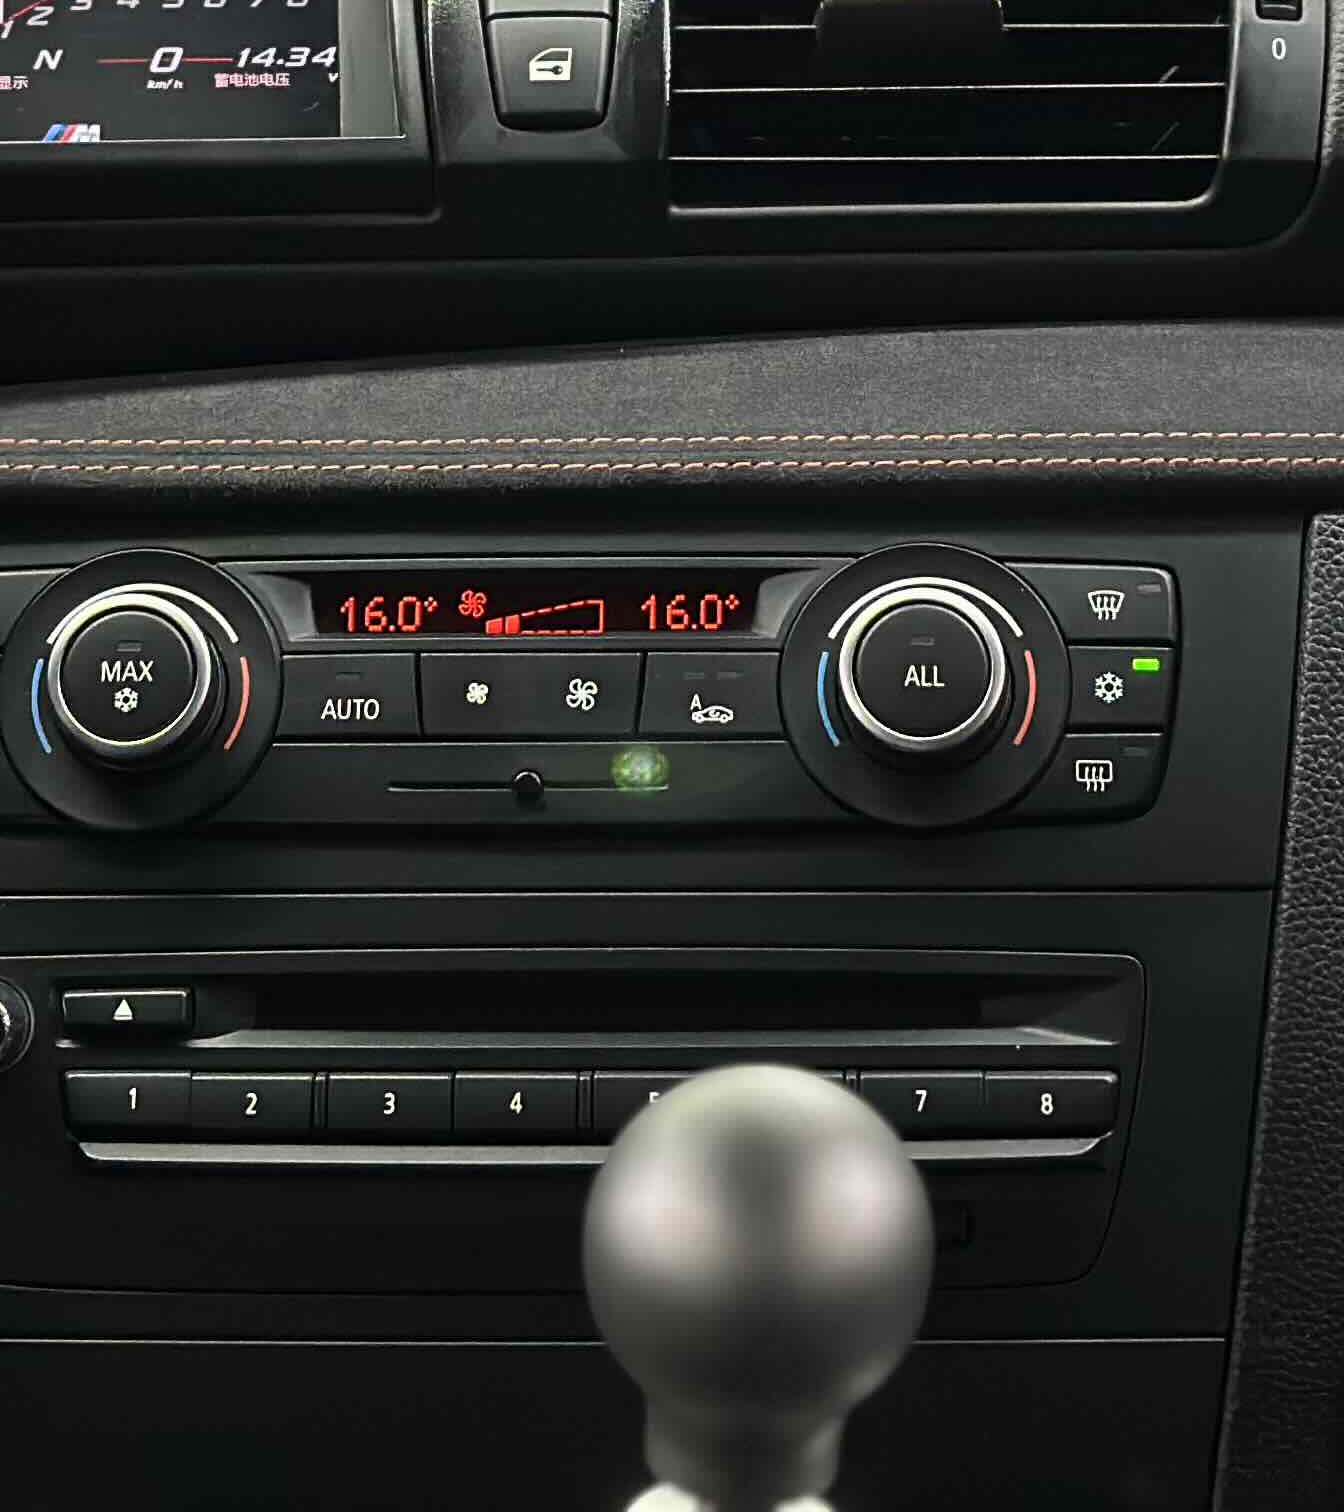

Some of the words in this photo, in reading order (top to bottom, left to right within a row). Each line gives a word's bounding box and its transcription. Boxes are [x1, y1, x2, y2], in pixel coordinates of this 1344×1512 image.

[0, 20, 14, 39] 1
[26, 6, 54, 26] 2
[32, 49, 64, 70] N
[149, 47, 184, 73] 0
[236, 46, 337, 68] 14.34
[146, 78, 184, 90] km/h
[214, 72, 291, 88] 蓄电池电压
[101, 660, 153, 683] MAX
[904, 664, 944, 688] ALL
[321, 698, 380, 721] AUTO
[129, 1087, 137, 1110] 1
[245, 1093, 257, 1115] 2
[383, 1093, 396, 1115] 3
[509, 1092, 523, 1114] 4
[914, 1090, 928, 1113] 7
[1040, 1093, 1054, 1116] 8
